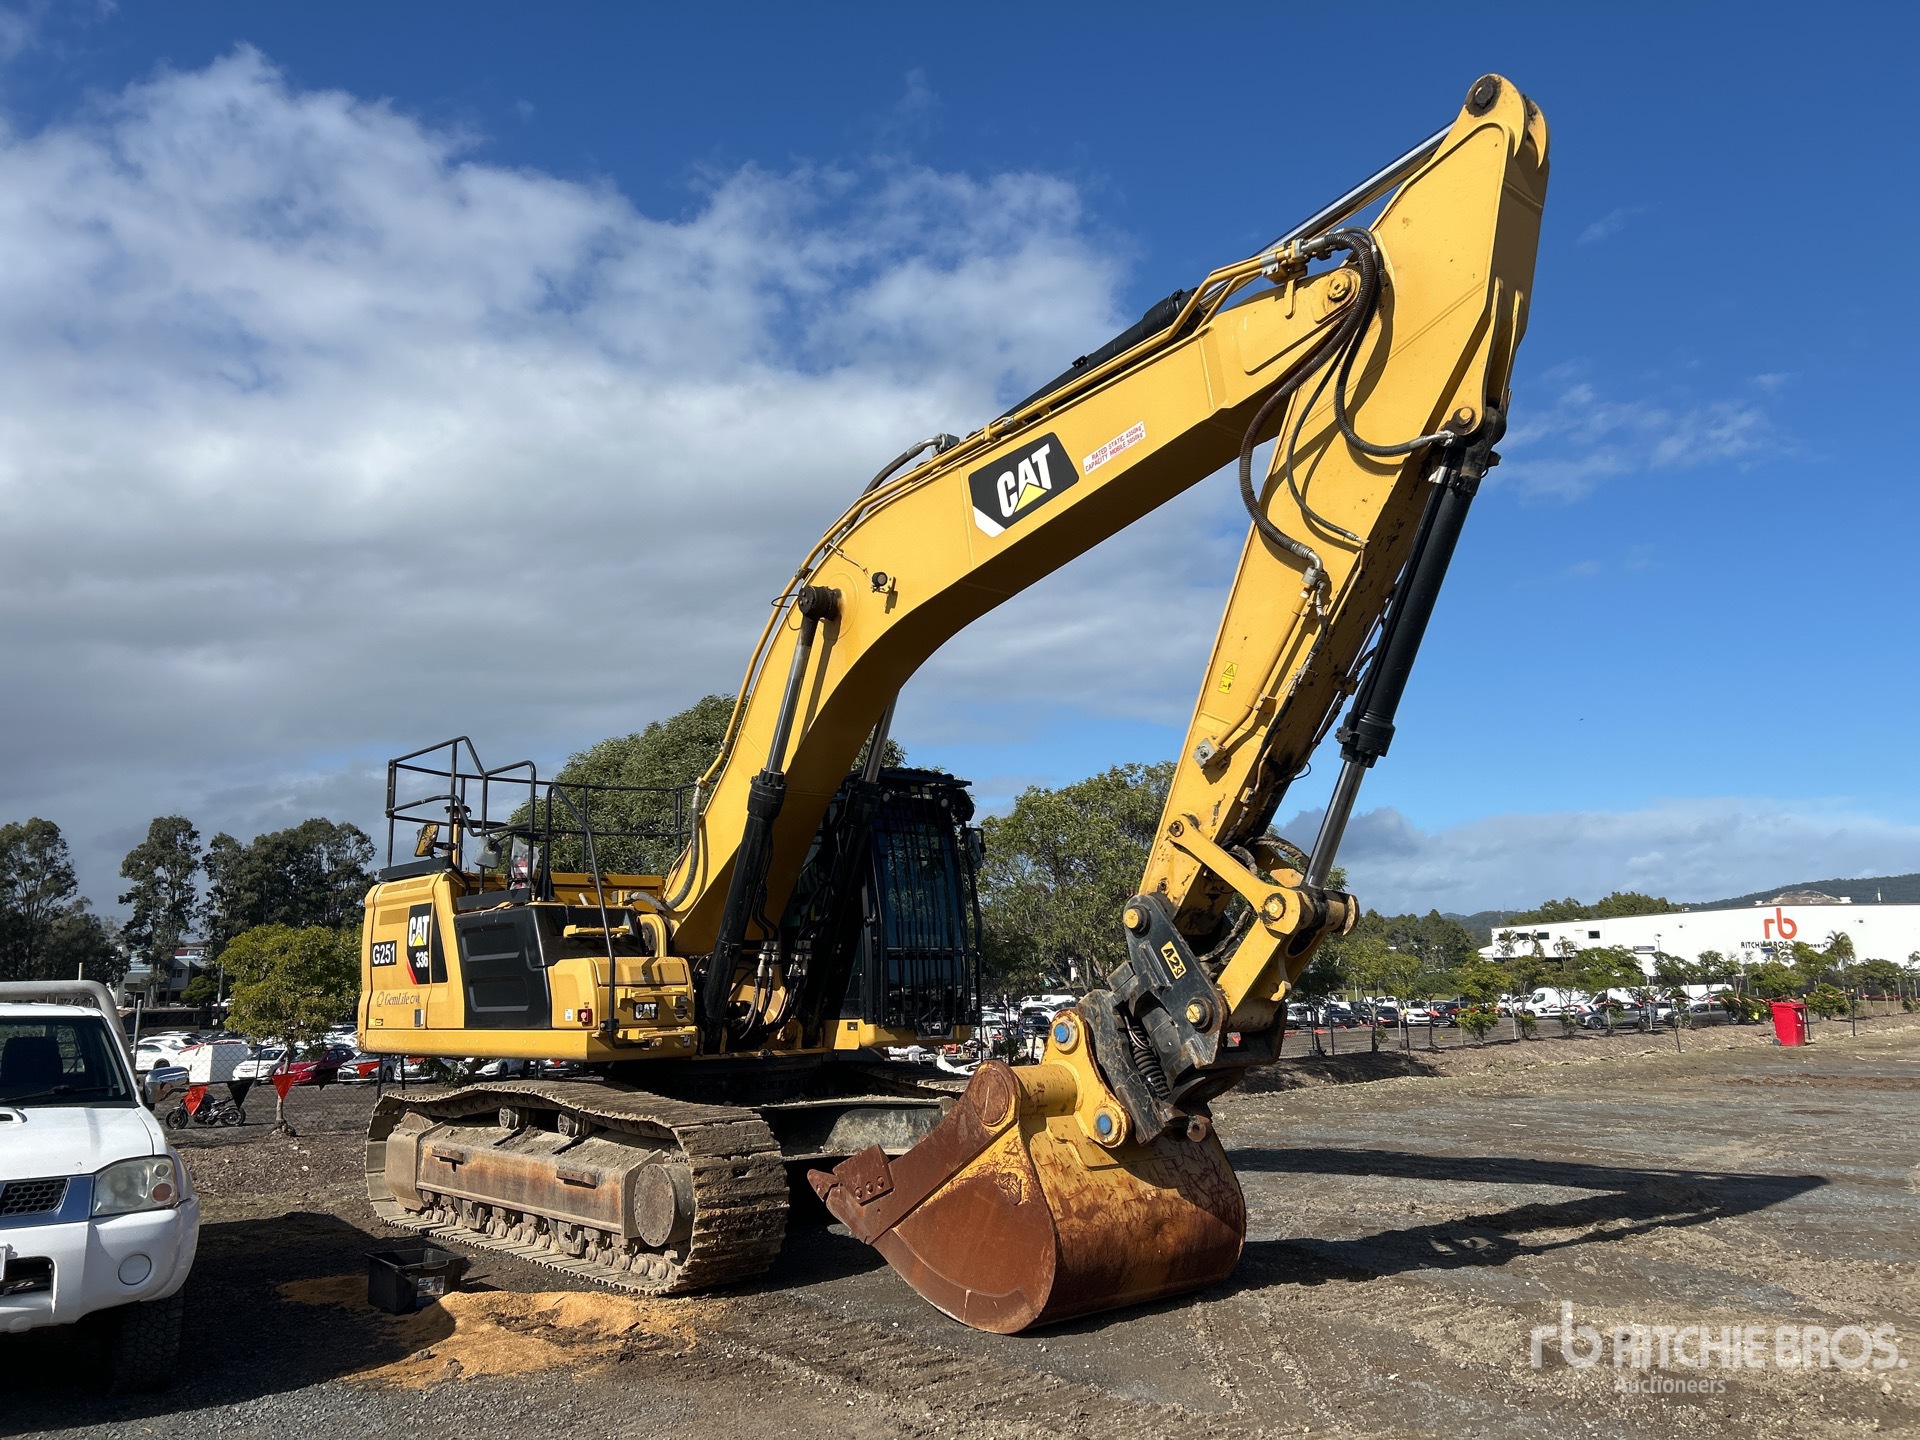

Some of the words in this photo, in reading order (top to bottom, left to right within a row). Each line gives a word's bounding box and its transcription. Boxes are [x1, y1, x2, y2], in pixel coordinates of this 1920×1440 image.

[1091, 446, 1108, 460] RATED
[1108, 435, 1125, 450] STATIC
[1085, 453, 1108, 472] CAPACITY
[997, 443, 1052, 518] CAT
[409, 915, 429, 947] CAT
[1764, 908, 1797, 939] rb
[373, 943, 395, 964] G251
[416, 951, 428, 968] 336
[636, 1004, 656, 1019] CAT
